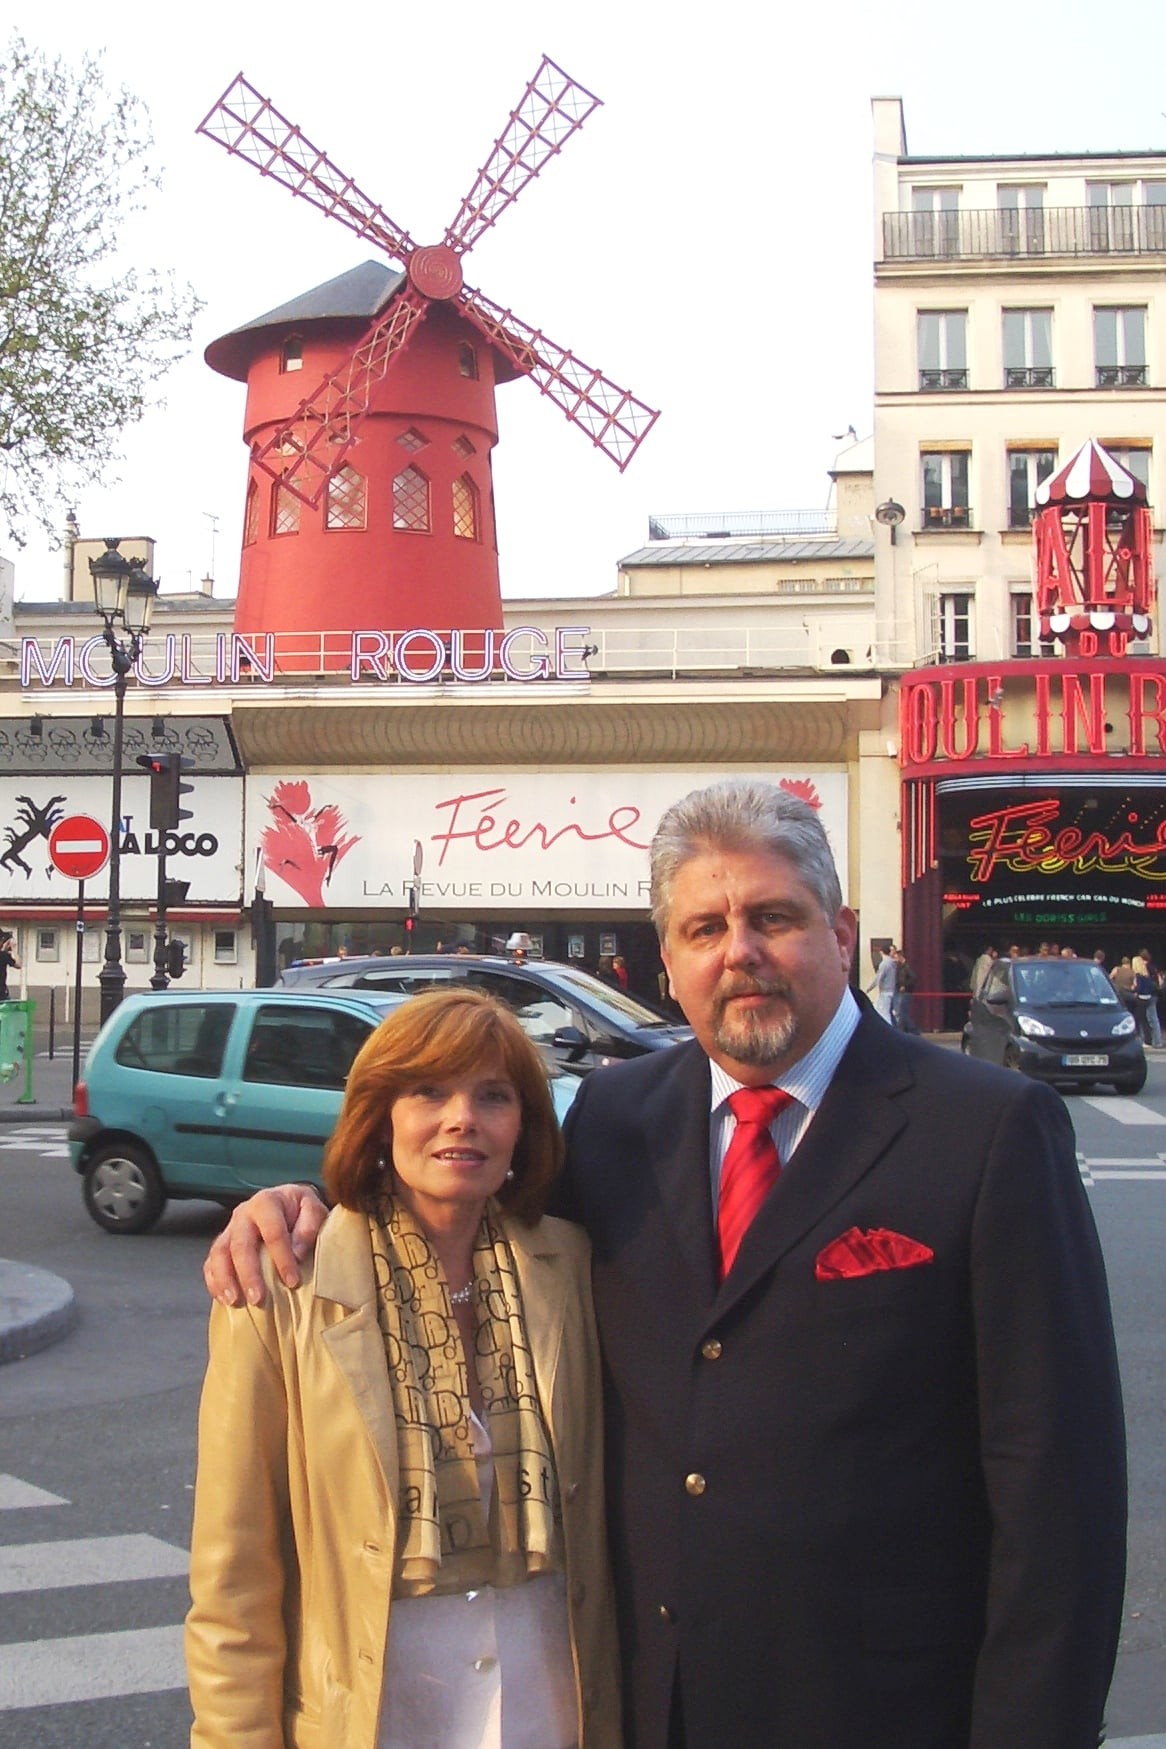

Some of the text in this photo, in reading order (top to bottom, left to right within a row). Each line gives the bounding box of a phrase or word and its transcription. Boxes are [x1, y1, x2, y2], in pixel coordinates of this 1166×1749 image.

[22, 626, 591, 687] MOULIN ROUGE
[1080, 631, 1127, 657] DU
[431, 787, 651, 866] Féerie
[145, 833, 218, 857] LOCO
[363, 880, 394, 897] LA
[491, 882, 522, 897] DU
[532, 880, 628, 897] MOULIN
